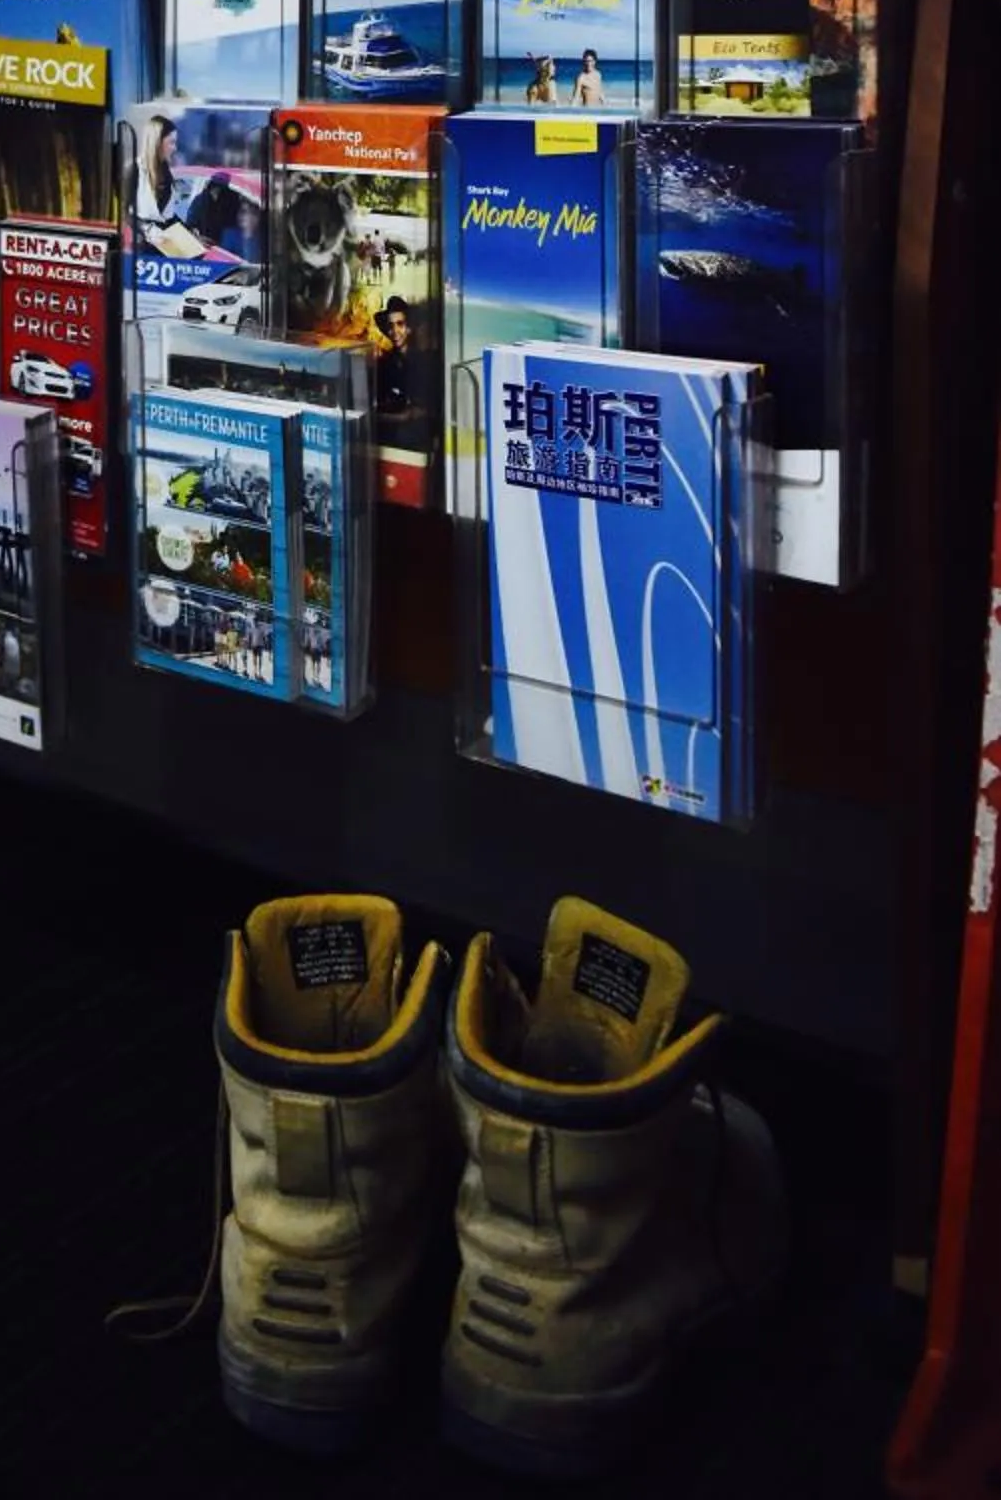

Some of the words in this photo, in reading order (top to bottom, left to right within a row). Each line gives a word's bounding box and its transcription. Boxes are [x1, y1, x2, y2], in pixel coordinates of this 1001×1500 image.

[713, 41, 736, 54] Eco
[742, 41, 780, 54] Tents
[26, 56, 95, 89] ROCK
[307, 125, 362, 144] Yanchep
[345, 144, 391, 159] National
[393, 147, 417, 162] Park
[462, 197, 551, 247] Monkey
[552, 203, 598, 240] Mia
[6, 234, 105, 263] RENT-A-CAR
[15, 261, 44, 279] 1800
[47, 264, 104, 286] ACERENT
[136, 259, 175, 287] $20
[15, 287, 89, 317] GREAT
[13, 315, 93, 347] PRICES
[59, 416, 93, 433] more
[150, 403, 189, 428] PERTH
[194, 411, 269, 444] FREMANTLE
[503, 381, 621, 451] 珀斯
[505, 439, 620, 483] 旅游指南
